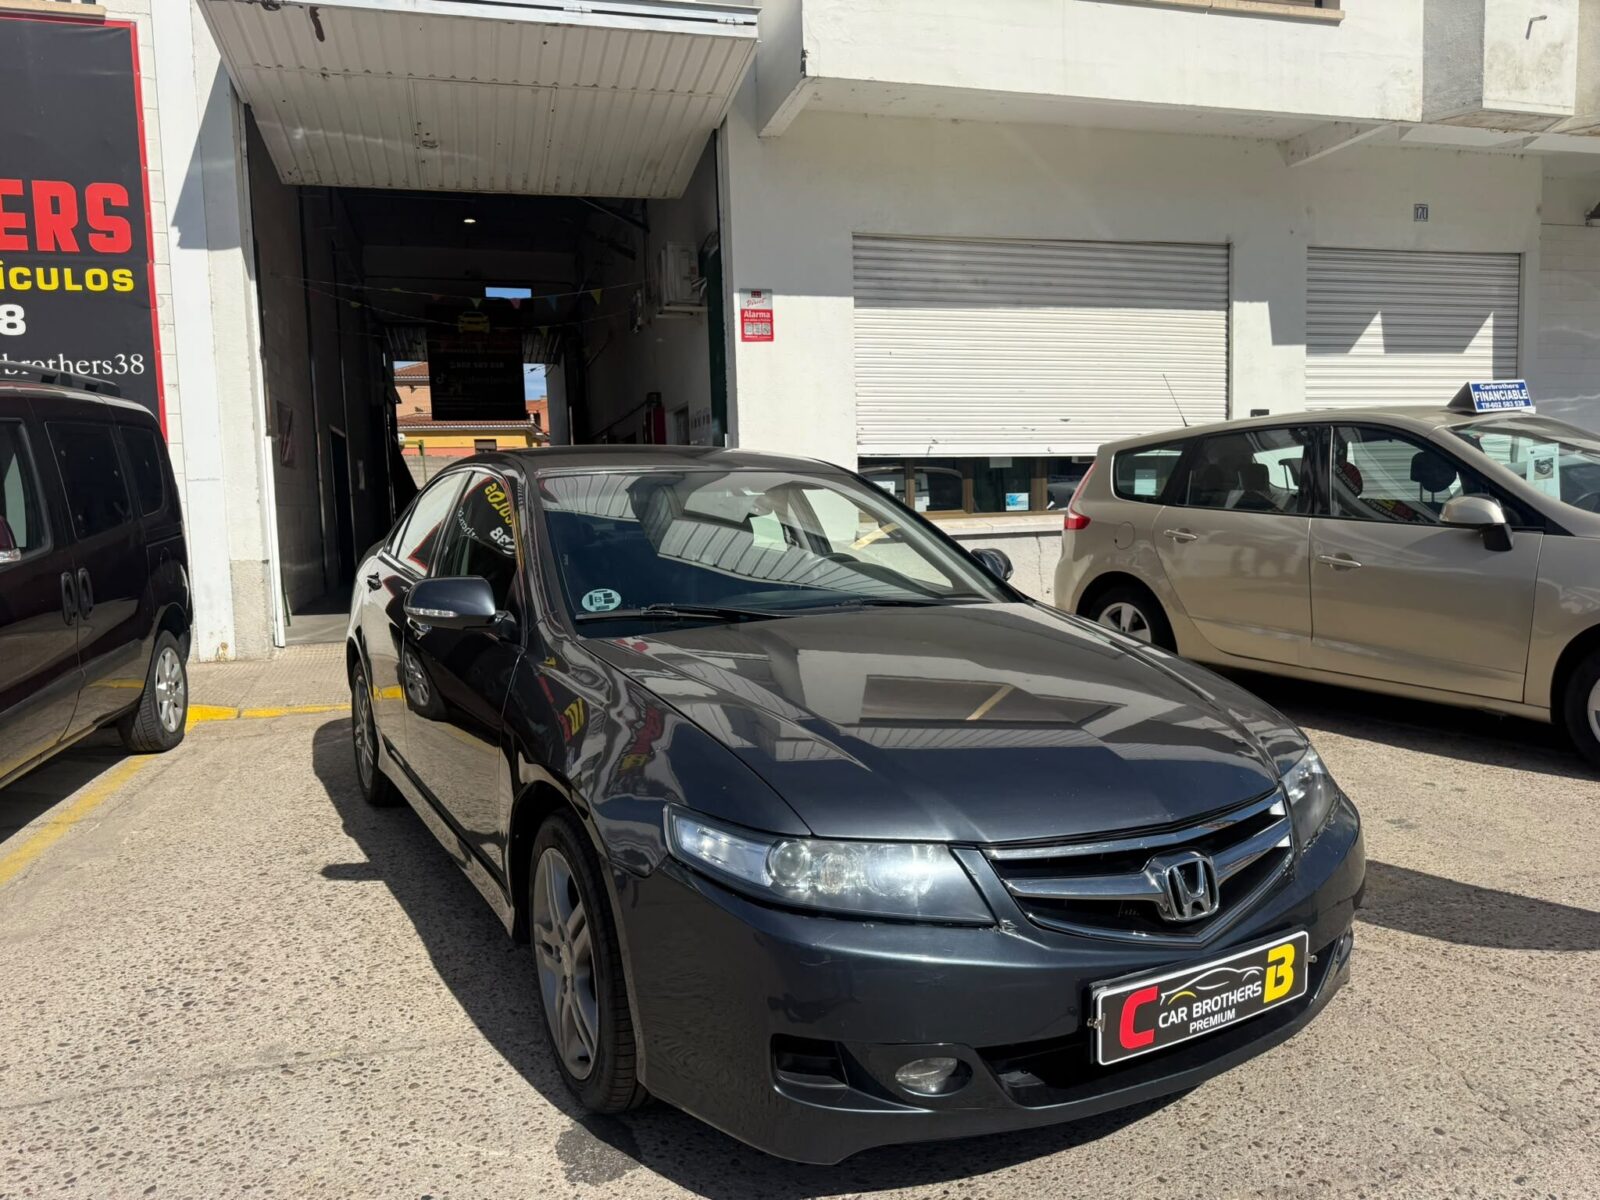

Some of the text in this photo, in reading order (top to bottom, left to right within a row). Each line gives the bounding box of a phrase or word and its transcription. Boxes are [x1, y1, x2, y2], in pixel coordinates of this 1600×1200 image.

[744, 310, 770, 318] Alarma
[1475, 390, 1528, 402] FINANCIABLE
[1119, 985, 1158, 1049] C
[1158, 981, 1263, 1028] CAR BROTHERS
[1189, 1008, 1236, 1034] PREMIUM
